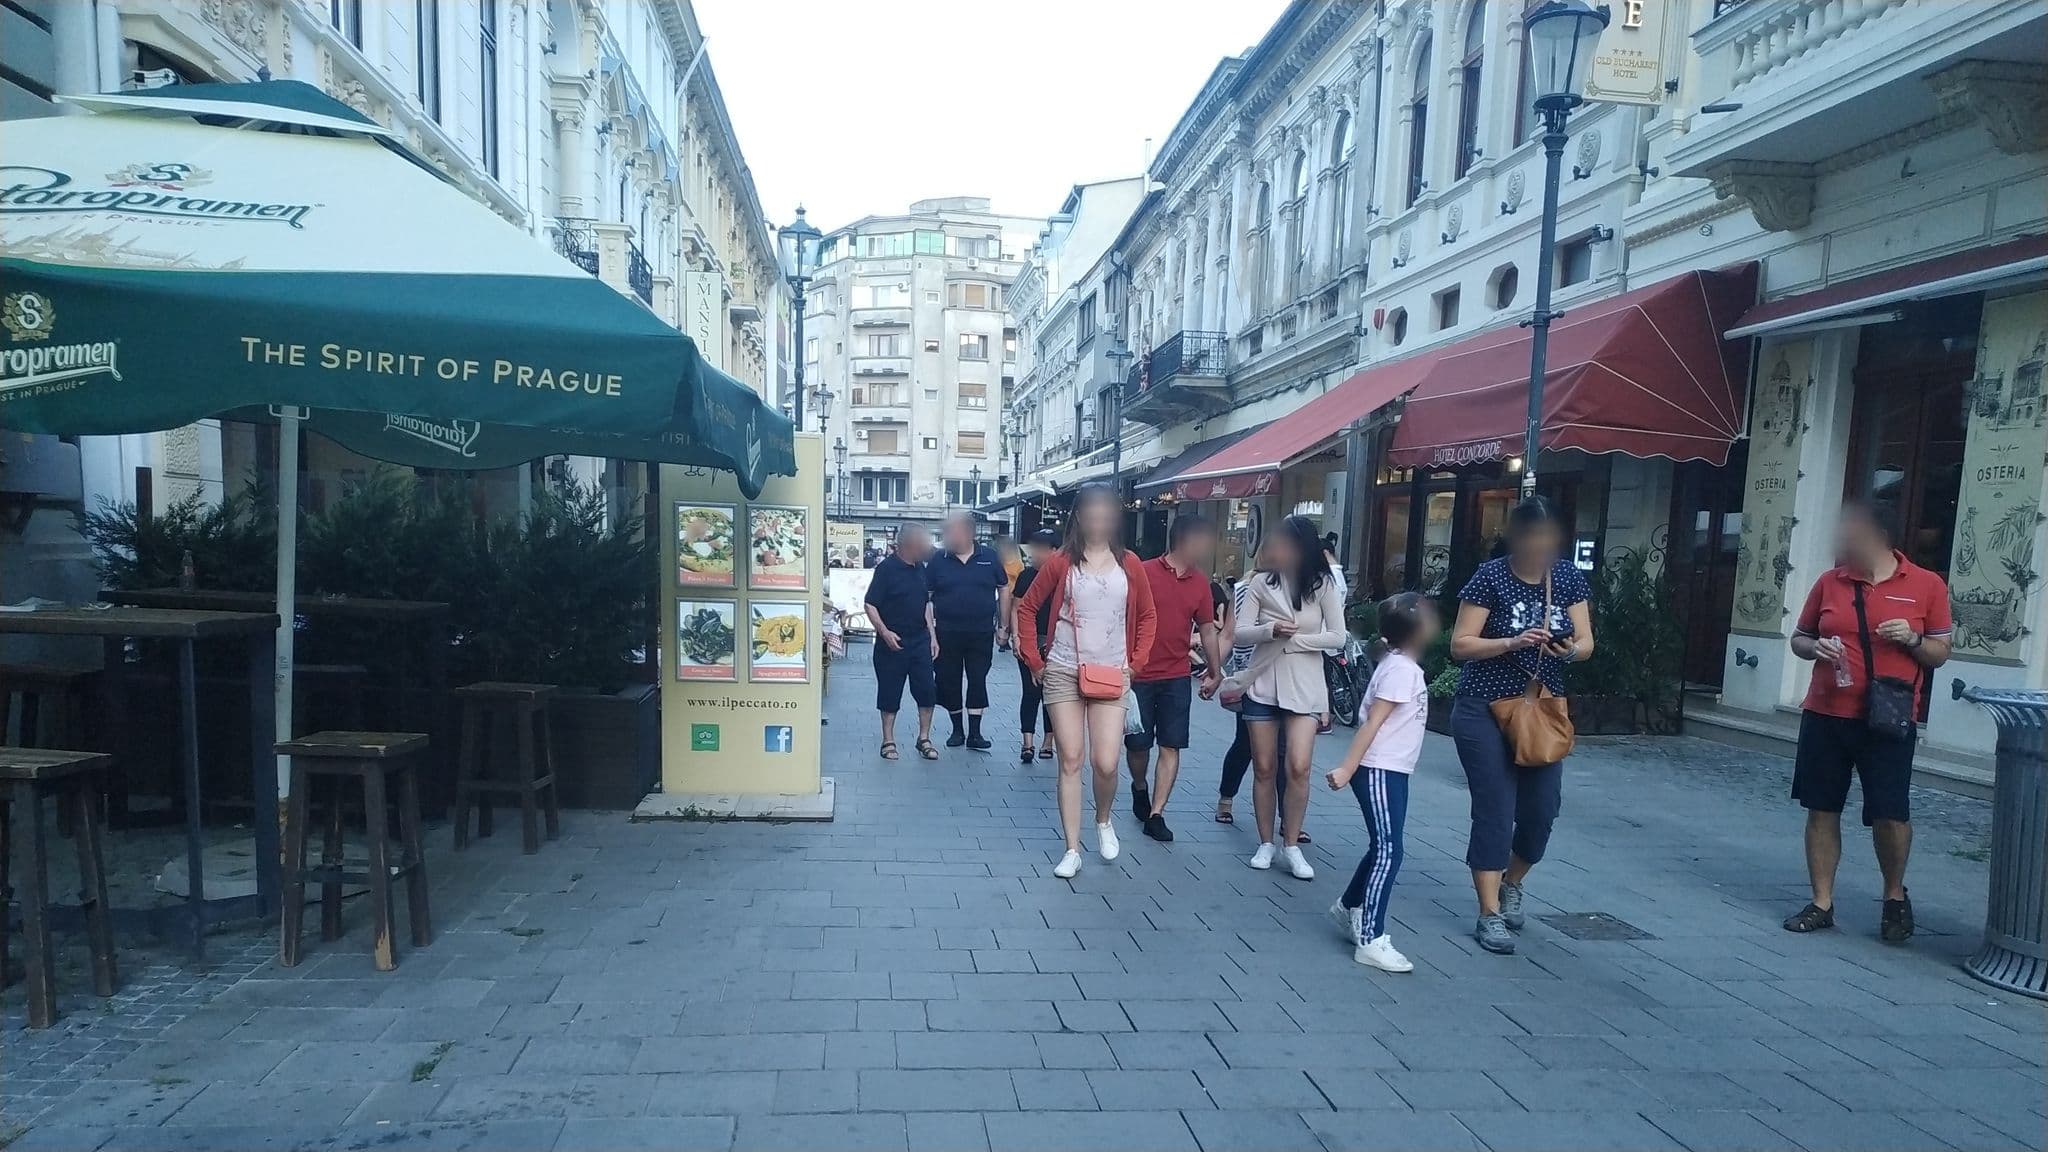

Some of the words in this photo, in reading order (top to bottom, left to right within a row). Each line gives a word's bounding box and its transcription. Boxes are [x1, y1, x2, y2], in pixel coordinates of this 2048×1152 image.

[1613, 70, 1639, 79] HOTEL
[106, 213, 208, 226] PRAGUE
[240, 336, 306, 367] THE
[320, 343, 426, 378] SPIRIT
[437, 358, 480, 382] OF
[493, 359, 623, 397] PRAGUE
[36, 380, 77, 396] PRAGUE
[1434, 448, 1456, 462] HOTEL
[1457, 440, 1502, 461] CONCORDE
[1977, 465, 2026, 482] OSTERIA
[1755, 477, 1786, 491] OSTERIA
[687, 696, 798, 711] www.ilpeccato.ro
